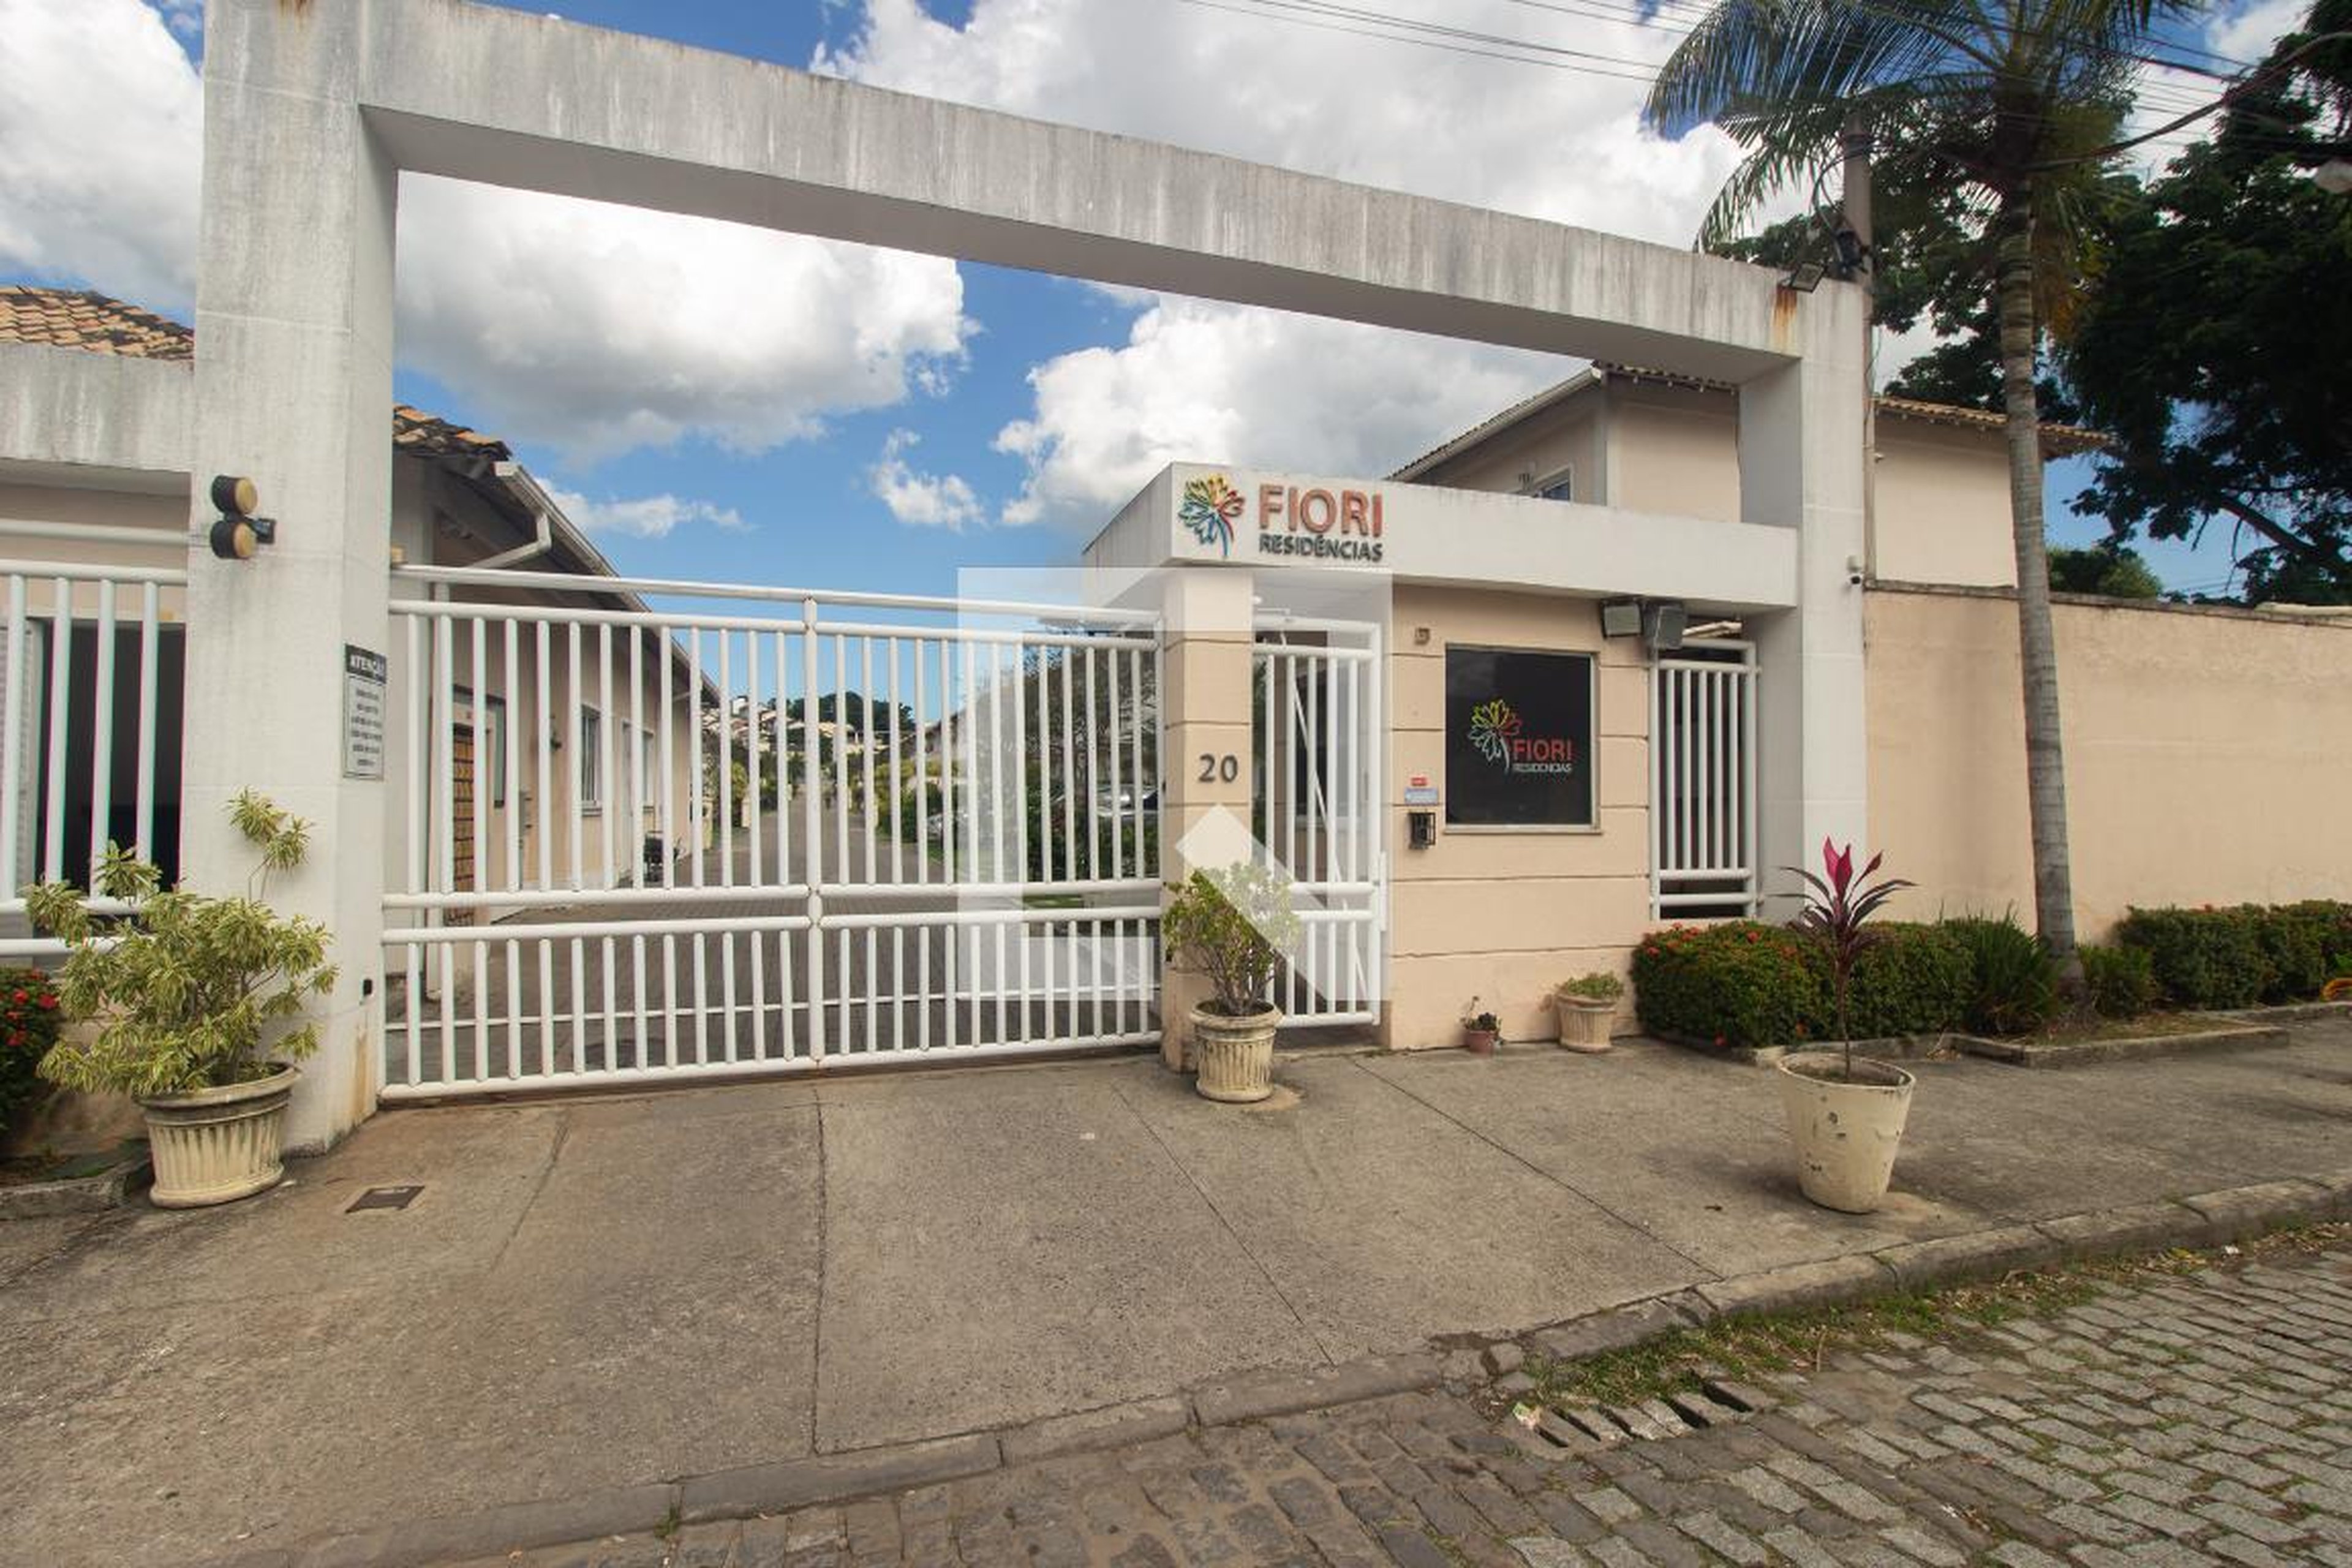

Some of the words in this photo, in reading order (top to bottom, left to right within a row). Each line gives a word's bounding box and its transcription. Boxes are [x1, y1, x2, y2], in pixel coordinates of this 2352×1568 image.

[1259, 484, 1382, 537] FIORI
[1259, 533, 1382, 562] RESIDÊNCIAS
[1515, 739, 1572, 761] FIORI
[1199, 753, 1238, 783] 20
